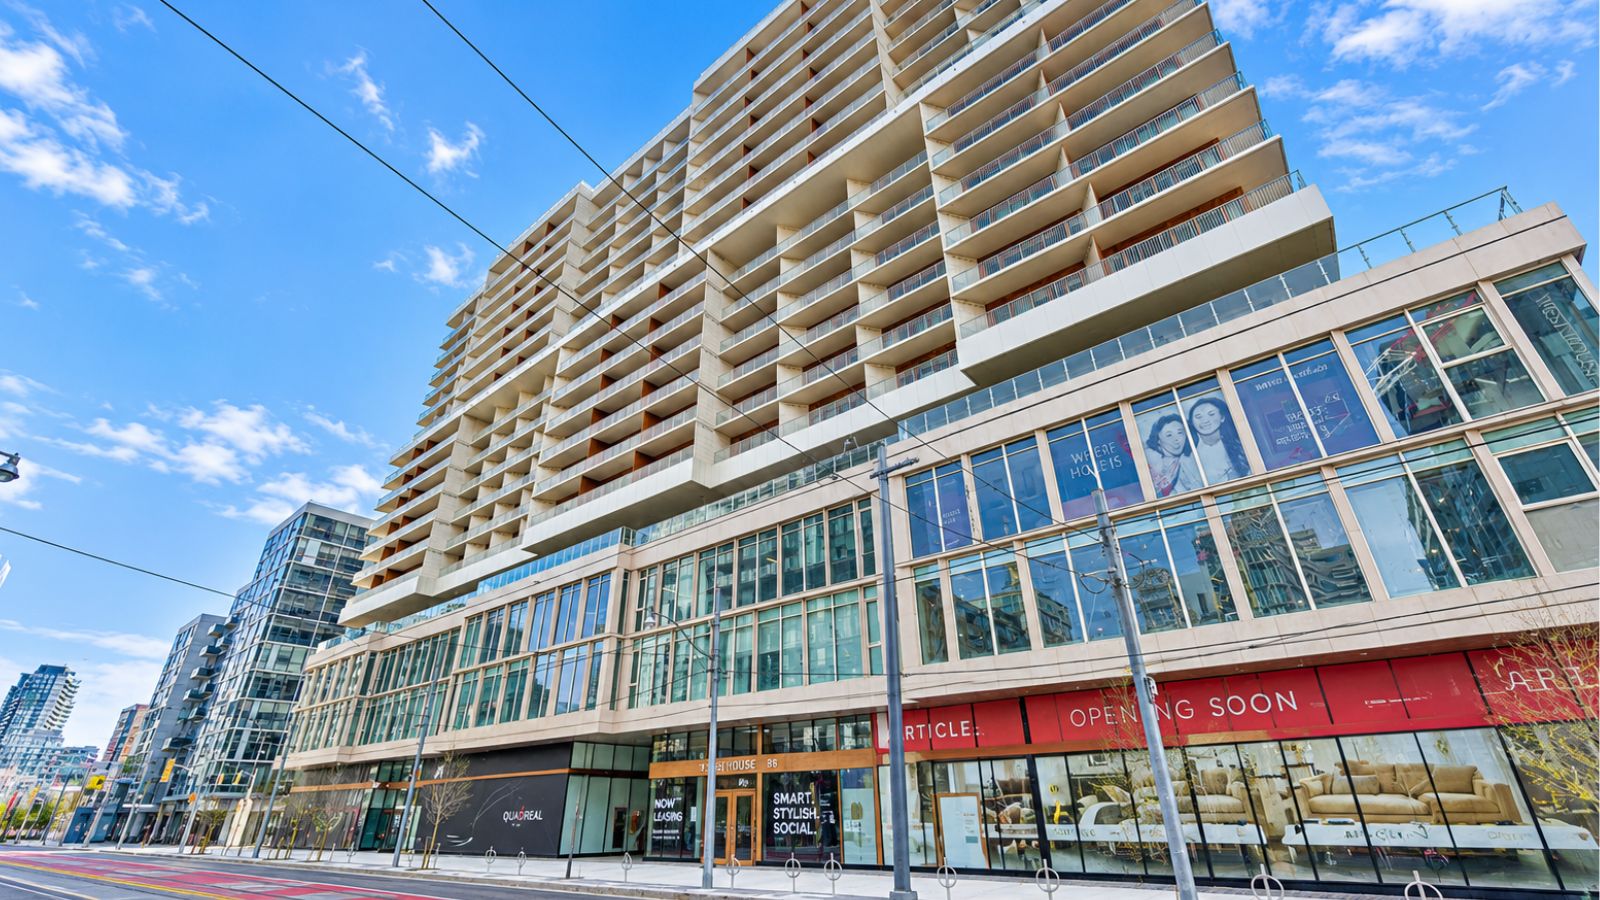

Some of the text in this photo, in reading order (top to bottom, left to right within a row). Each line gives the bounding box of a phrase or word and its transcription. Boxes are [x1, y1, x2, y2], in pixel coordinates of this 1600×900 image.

[1070, 455, 1122, 479] HOE IS
[1070, 690, 1298, 727] OPENNG SOON
[655, 798, 676, 808] NOW
[773, 791, 815, 804] SMART.
[773, 807, 819, 820] STYLISH.
[773, 822, 817, 835] SOCIAL.
